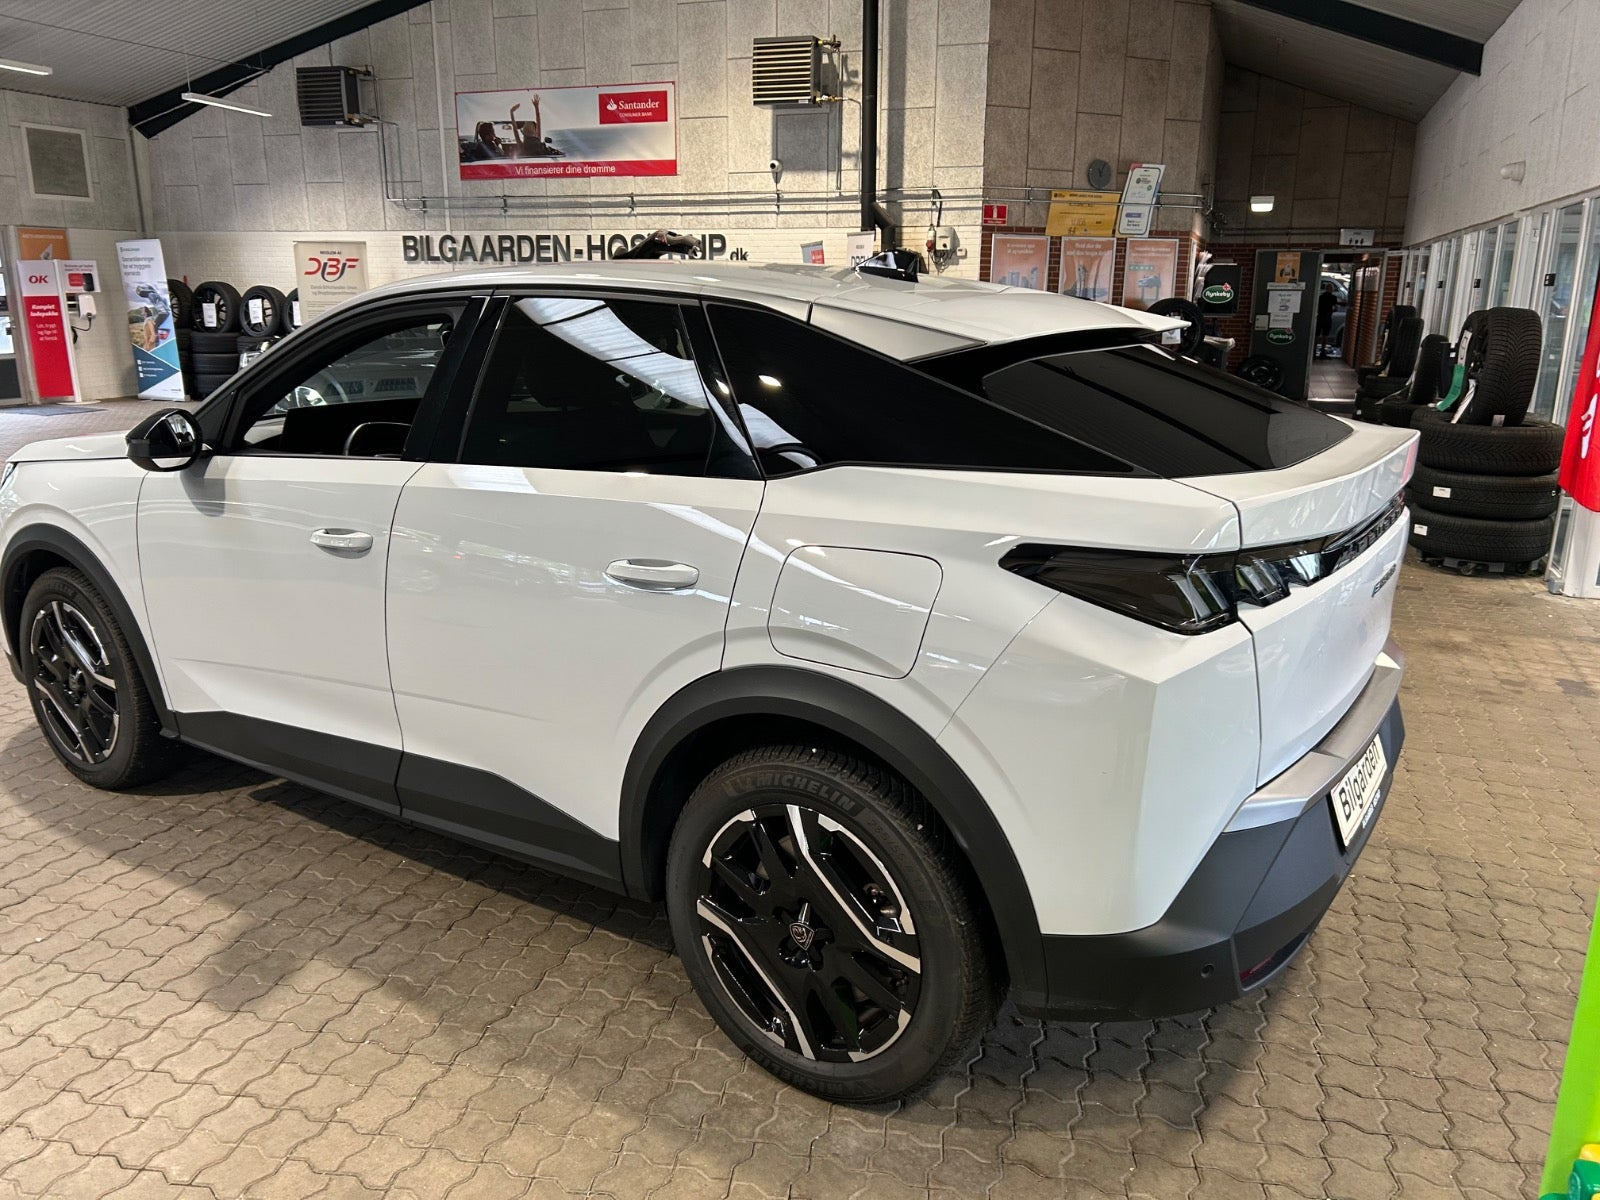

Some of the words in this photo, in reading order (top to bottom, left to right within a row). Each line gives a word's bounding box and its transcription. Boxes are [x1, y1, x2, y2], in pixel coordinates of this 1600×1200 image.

[618, 98, 660, 110] Santander
[515, 166, 524, 175] Vi
[525, 165, 563, 175] finansierer
[565, 165, 582, 174] dine
[583, 164, 616, 173] drømme
[29, 275, 48, 284] OK
[756, 773, 857, 811] MICHELIN
